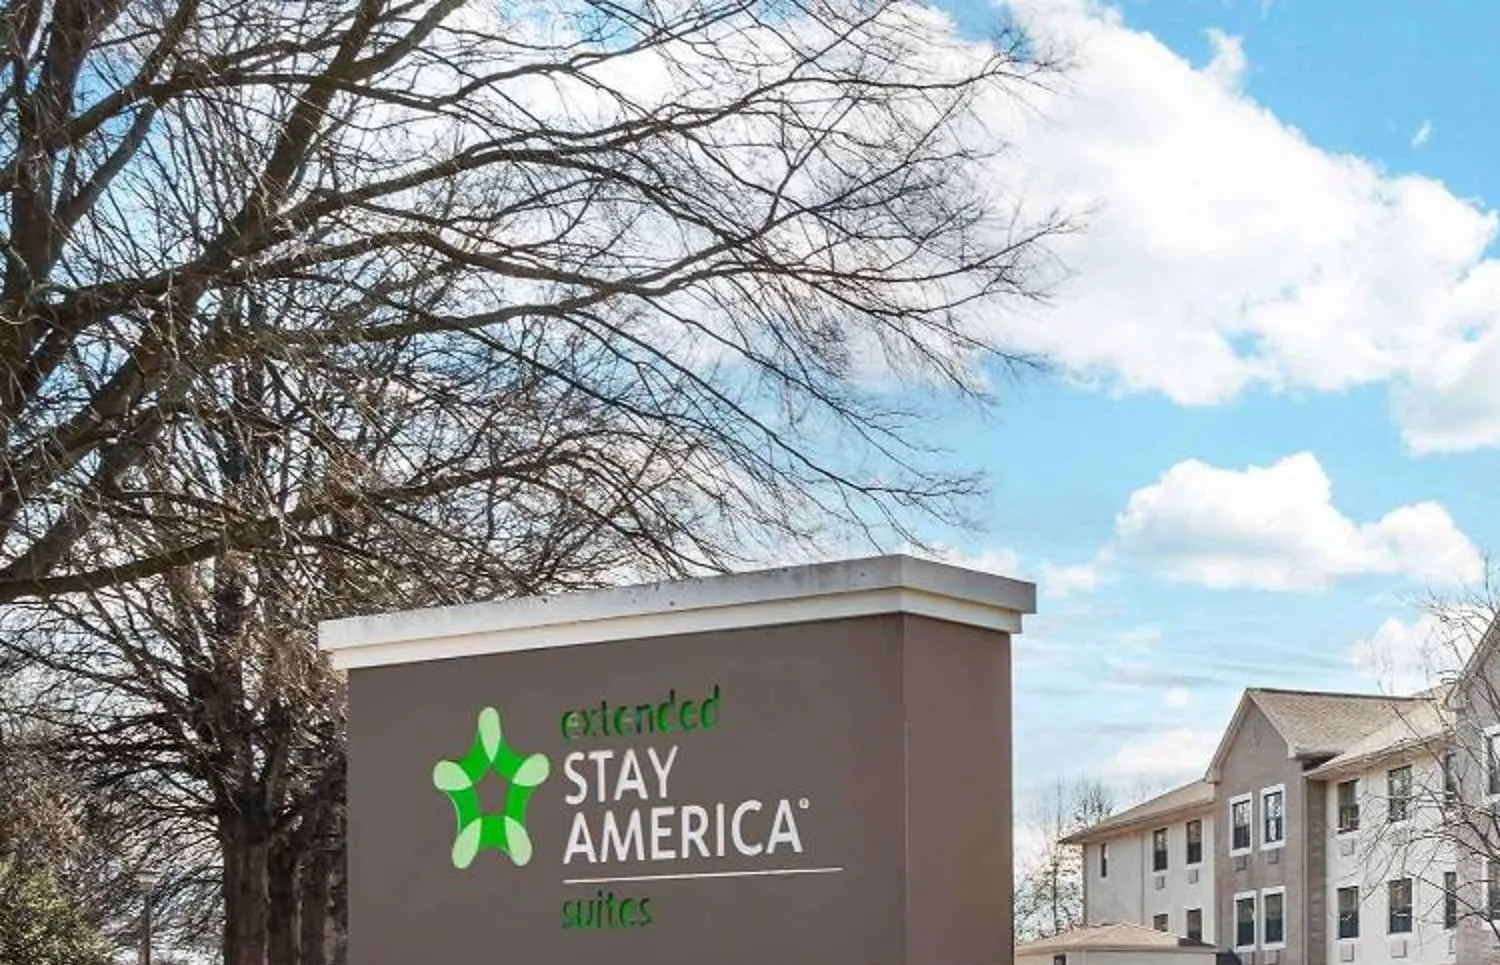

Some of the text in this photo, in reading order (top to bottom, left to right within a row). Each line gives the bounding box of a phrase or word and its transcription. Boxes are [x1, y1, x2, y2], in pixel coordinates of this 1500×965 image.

[561, 684, 721, 738] extended
[563, 745, 678, 804] STAY
[561, 890, 652, 929] suites
